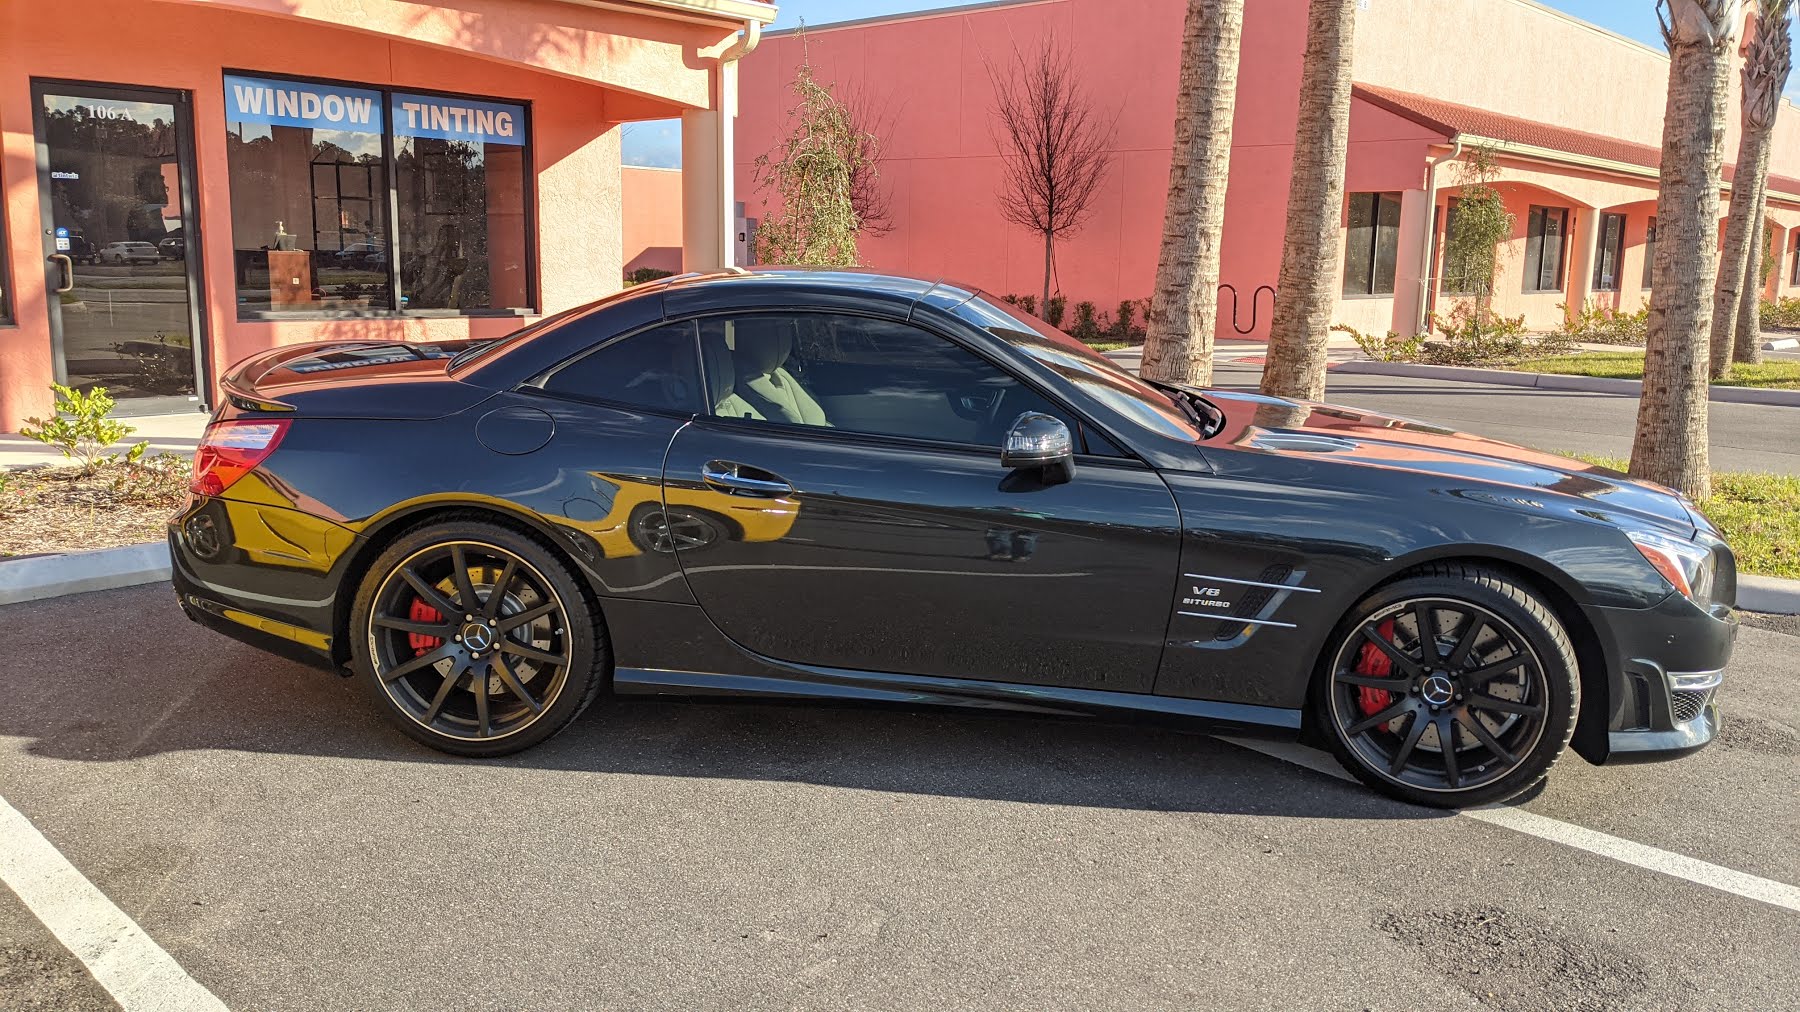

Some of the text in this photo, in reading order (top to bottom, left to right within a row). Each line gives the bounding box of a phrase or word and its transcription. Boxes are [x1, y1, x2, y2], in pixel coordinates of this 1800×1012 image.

[88, 104, 134, 121] 106 A
[233, 84, 513, 137] WINDOW TINTING
[1192, 586, 1220, 597] V8
[1182, 597, 1231, 608] BITURBO
